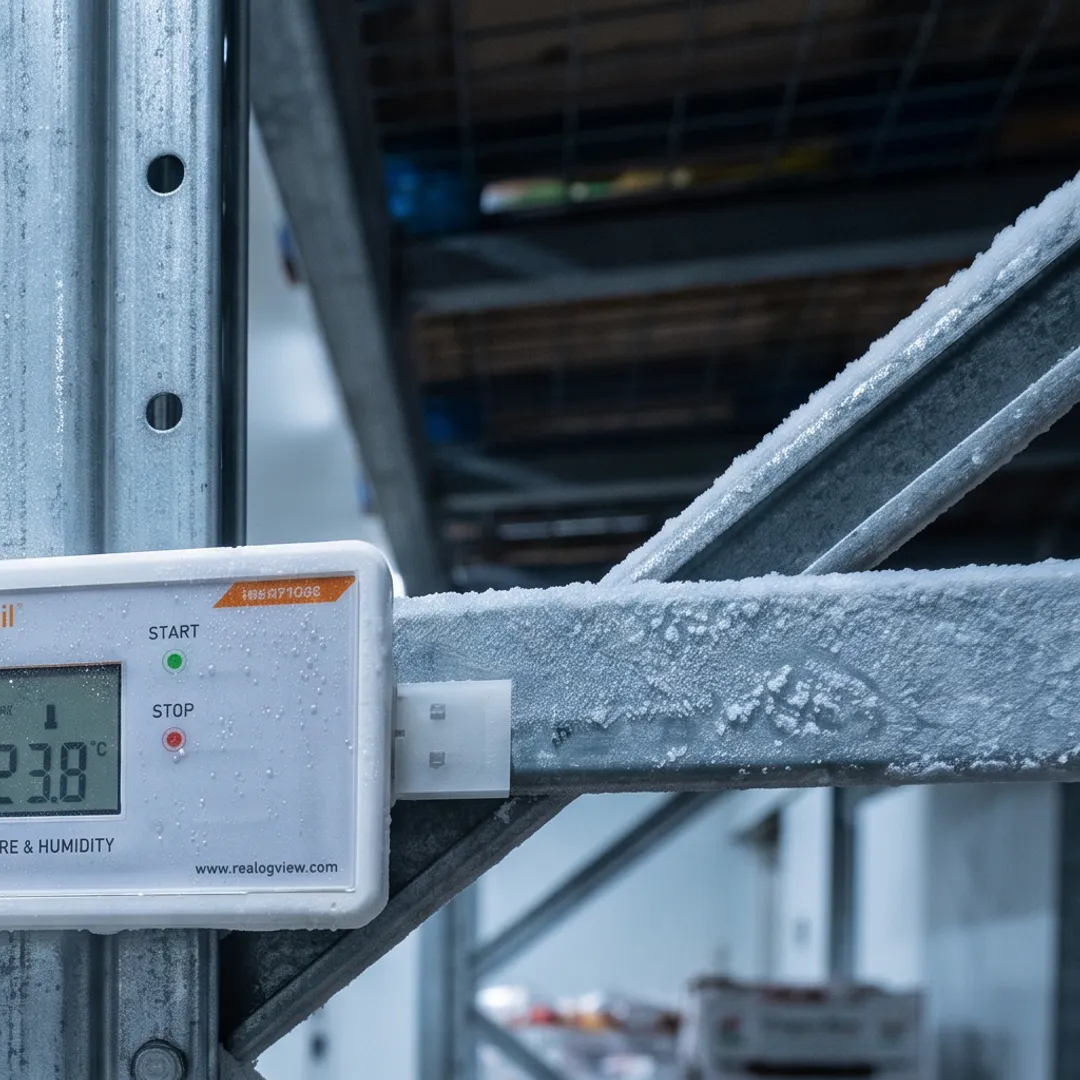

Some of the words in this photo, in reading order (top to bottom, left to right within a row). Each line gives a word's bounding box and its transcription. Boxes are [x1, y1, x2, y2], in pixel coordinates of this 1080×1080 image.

[149, 624, 199, 641] START
[153, 703, 194, 719] STOP
[24, 840, 33, 855] &
[39, 838, 114, 854] HUMIDITY
[196, 861, 337, 877] www.realogview.com
